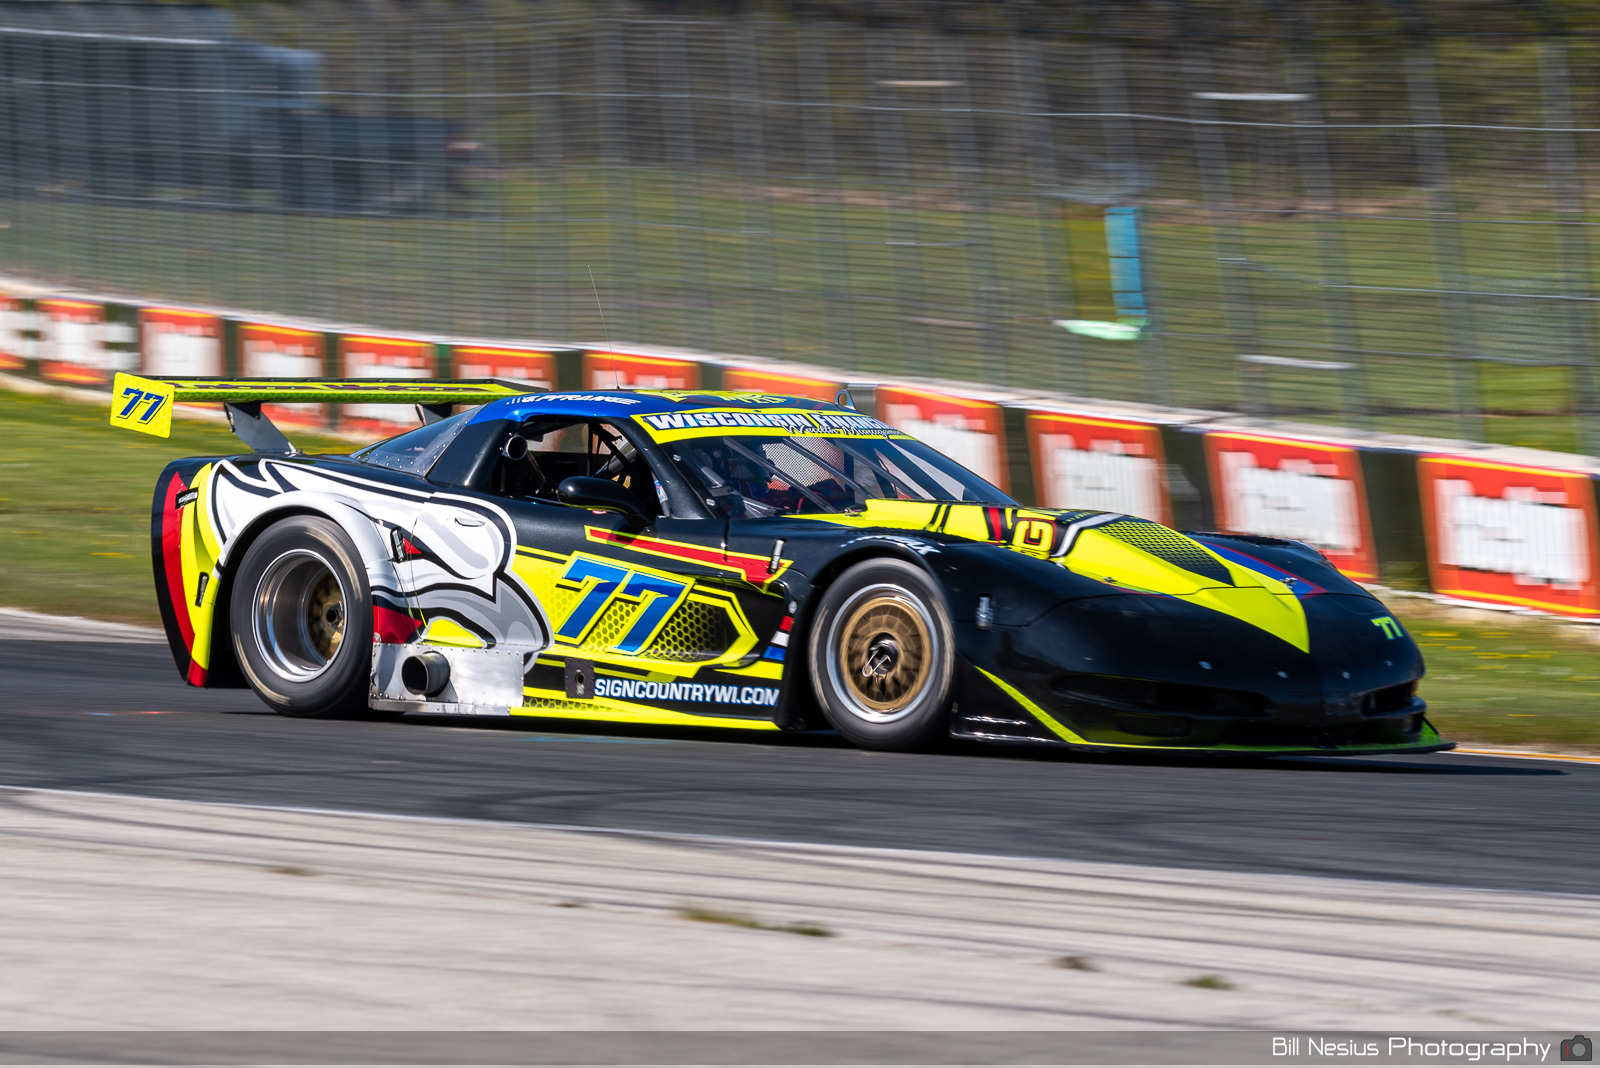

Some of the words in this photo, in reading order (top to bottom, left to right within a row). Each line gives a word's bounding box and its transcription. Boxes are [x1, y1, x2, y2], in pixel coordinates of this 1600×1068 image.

[118, 387, 167, 423] 77
[646, 412, 811, 430] WISCONSIN
[556, 554, 689, 654] 77
[1371, 616, 1404, 641] 77
